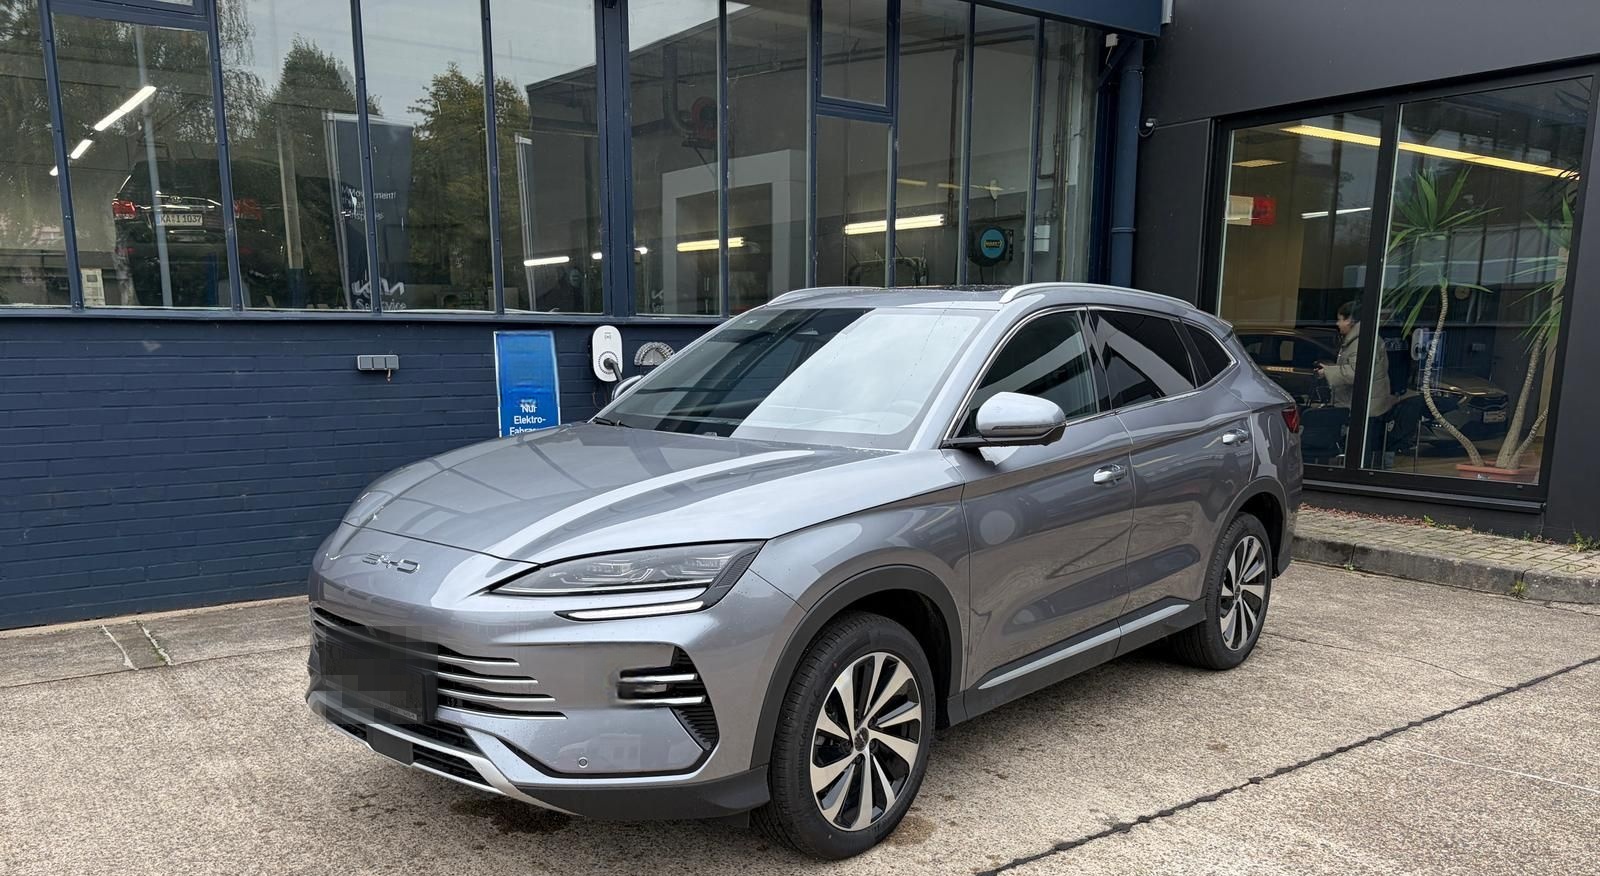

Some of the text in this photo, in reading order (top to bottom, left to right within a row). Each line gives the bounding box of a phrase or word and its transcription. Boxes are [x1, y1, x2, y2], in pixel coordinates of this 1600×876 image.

[520, 403, 537, 413] Nur
[513, 415, 547, 425] Elektro-
[362, 552, 420, 574] BYD
